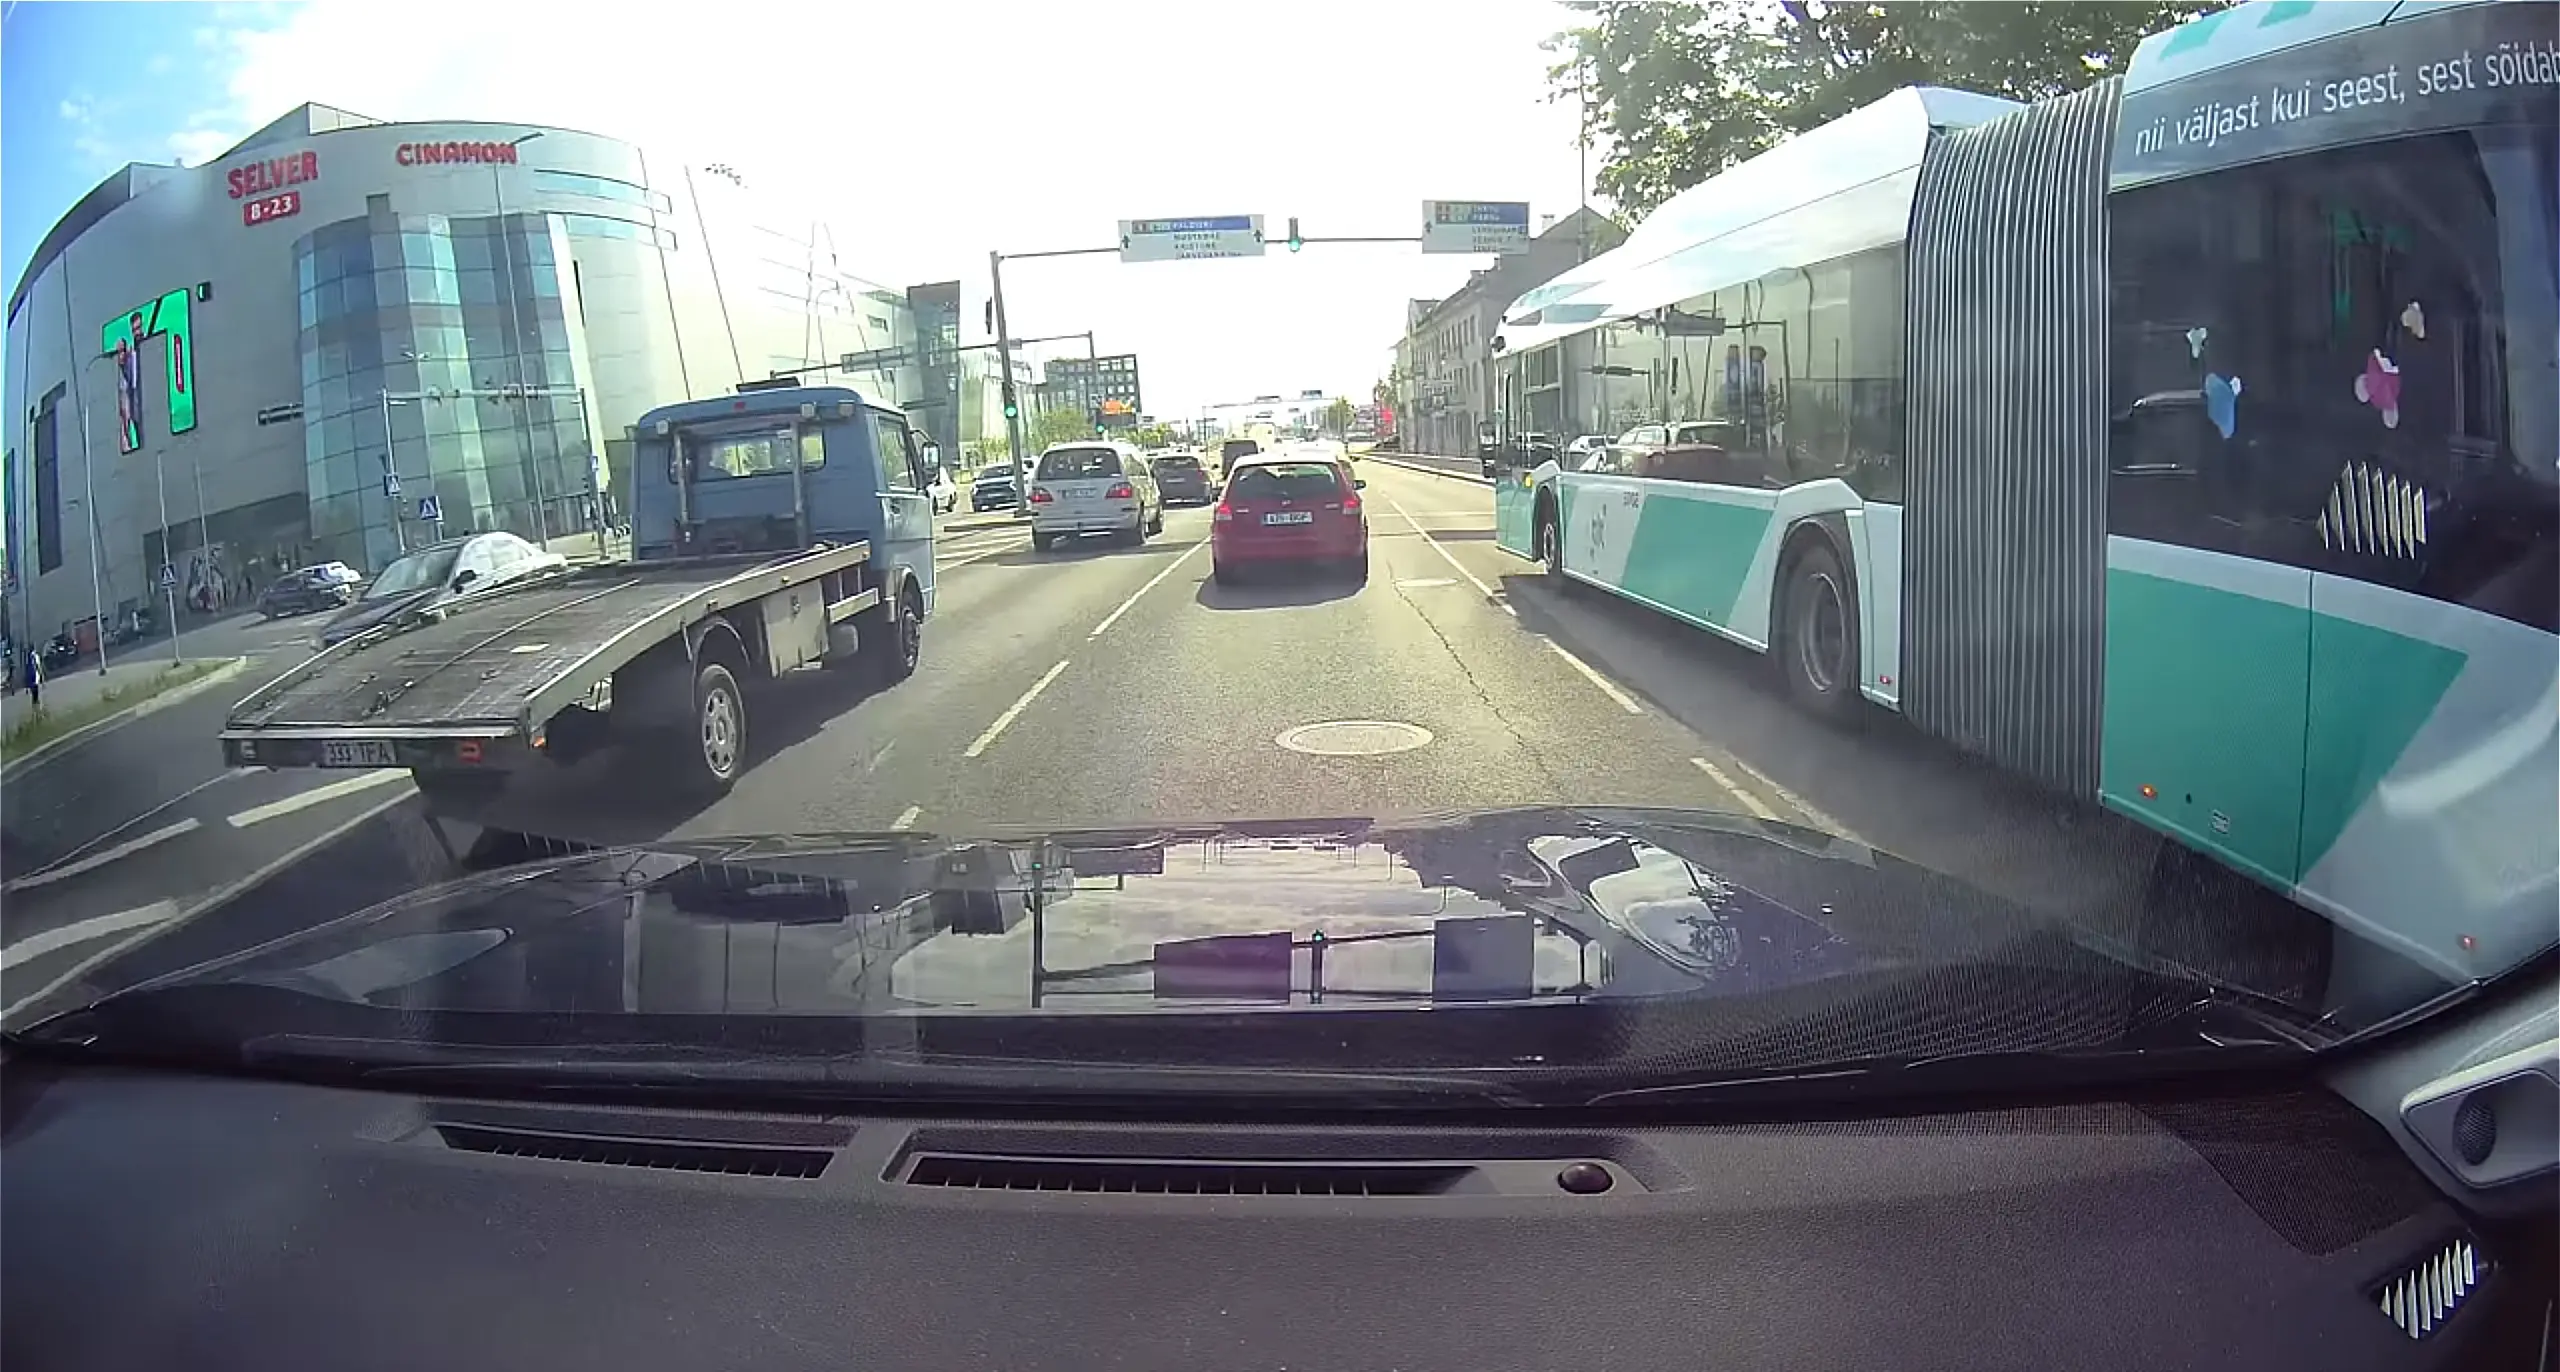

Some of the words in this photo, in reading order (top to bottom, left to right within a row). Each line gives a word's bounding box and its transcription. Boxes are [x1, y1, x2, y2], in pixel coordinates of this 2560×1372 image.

[2135, 119, 2166, 156] nii
[2175, 96, 2260, 147] väljast
[2271, 80, 2311, 125] kui
[2322, 65, 2406, 113] seest,
[2417, 51, 2475, 95] sest
[227, 151, 318, 199] SELVER
[396, 142, 517, 165] CINAMON
